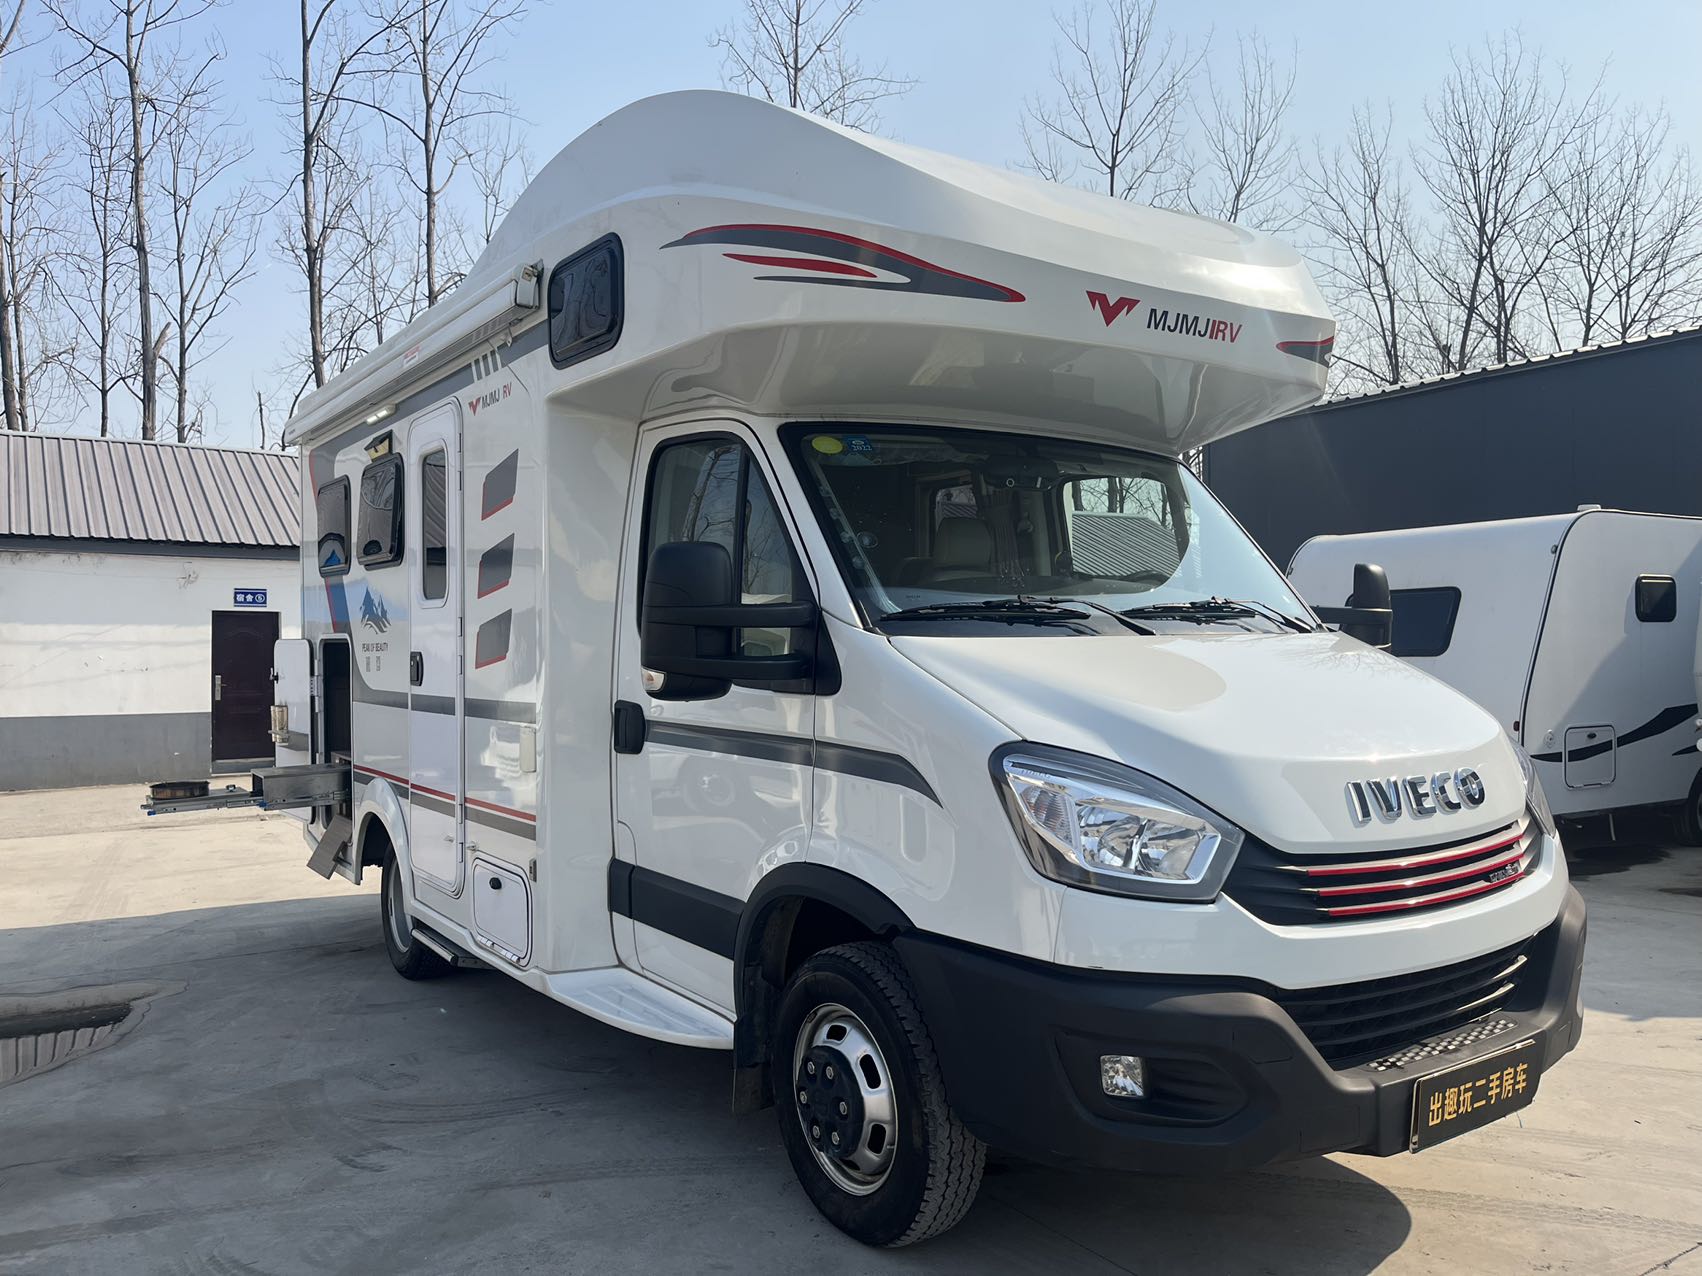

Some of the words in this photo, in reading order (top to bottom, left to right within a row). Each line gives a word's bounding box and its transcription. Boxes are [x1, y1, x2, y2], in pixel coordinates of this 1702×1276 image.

[481, 388, 500, 409] MJMJ
[503, 382, 512, 400] RV
[1345, 767, 1486, 825] IVECO
[1428, 1062, 1528, 1127] 出趣玩二手房车
